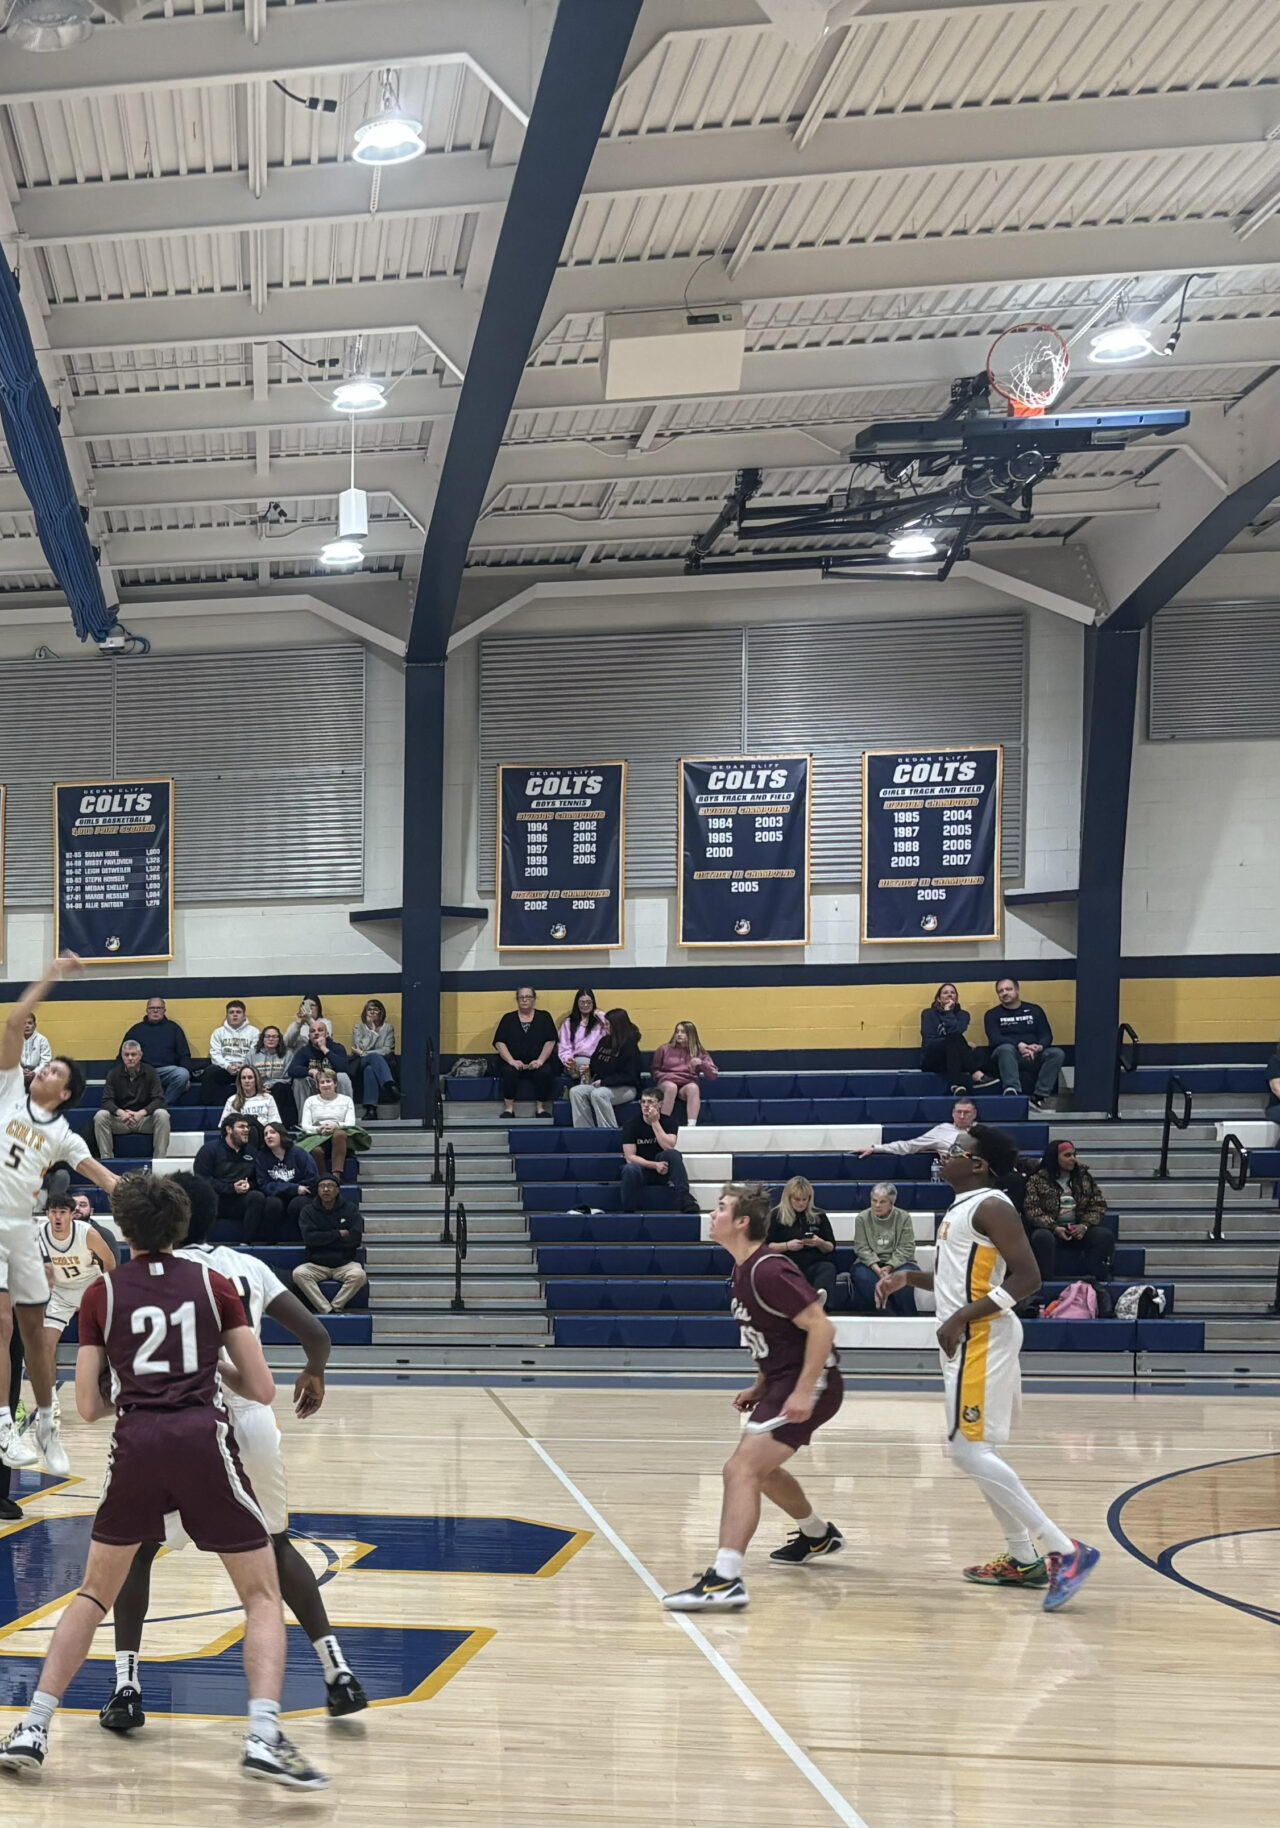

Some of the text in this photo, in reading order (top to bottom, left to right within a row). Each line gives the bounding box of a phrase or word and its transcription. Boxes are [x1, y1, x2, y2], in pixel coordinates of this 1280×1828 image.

[892, 761, 977, 784] COLTS
[525, 776, 603, 795] COLTS
[708, 769, 788, 790] COLTS
[80, 793, 152, 813] COLTS
[708, 817, 783, 828] 1984 2003
[894, 810, 972, 823] 1985 2004
[528, 822, 596, 831] 1994 2002
[894, 825, 972, 838] 1987 2005
[573, 833, 596, 842] 2003
[708, 831, 783, 843] 1985 2005
[527, 844, 596, 853] 1997 2004
[894, 840, 972, 852] 1988 2006
[706, 847, 733, 858] 2000
[527, 855, 596, 865] 1999 2005
[891, 854, 971, 867] 2003 2007
[525, 867, 548, 876] 2000
[731, 881, 759, 892] 2005
[917, 889, 946, 900] 2005
[525, 900, 595, 910] 2002 2005
[5, 1142, 25, 1170] 5
[61, 1266, 81, 1278] 13
[131, 1301, 199, 1376] 21
